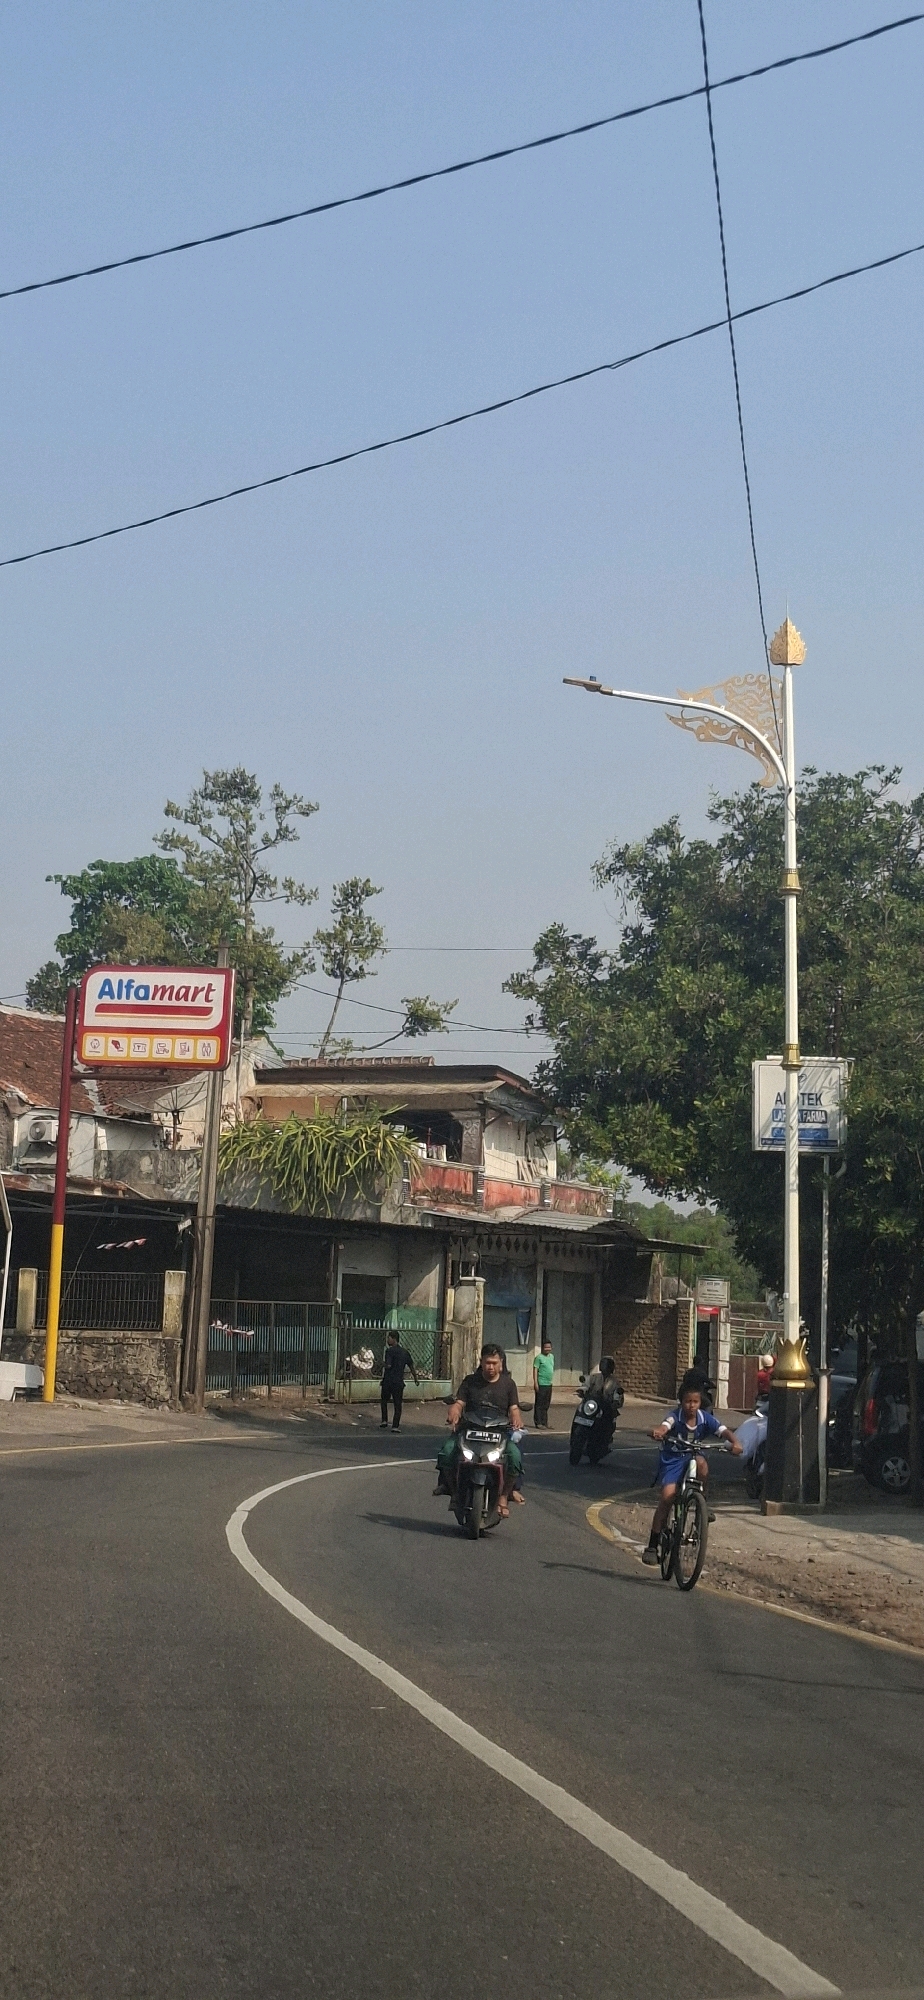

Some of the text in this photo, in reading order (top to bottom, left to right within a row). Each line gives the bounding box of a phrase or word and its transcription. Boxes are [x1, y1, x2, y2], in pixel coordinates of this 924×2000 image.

[98, 978, 216, 1003] Alfamart
[774, 1091, 823, 1106] ATEK
[802, 1110, 826, 1122] FARMA
